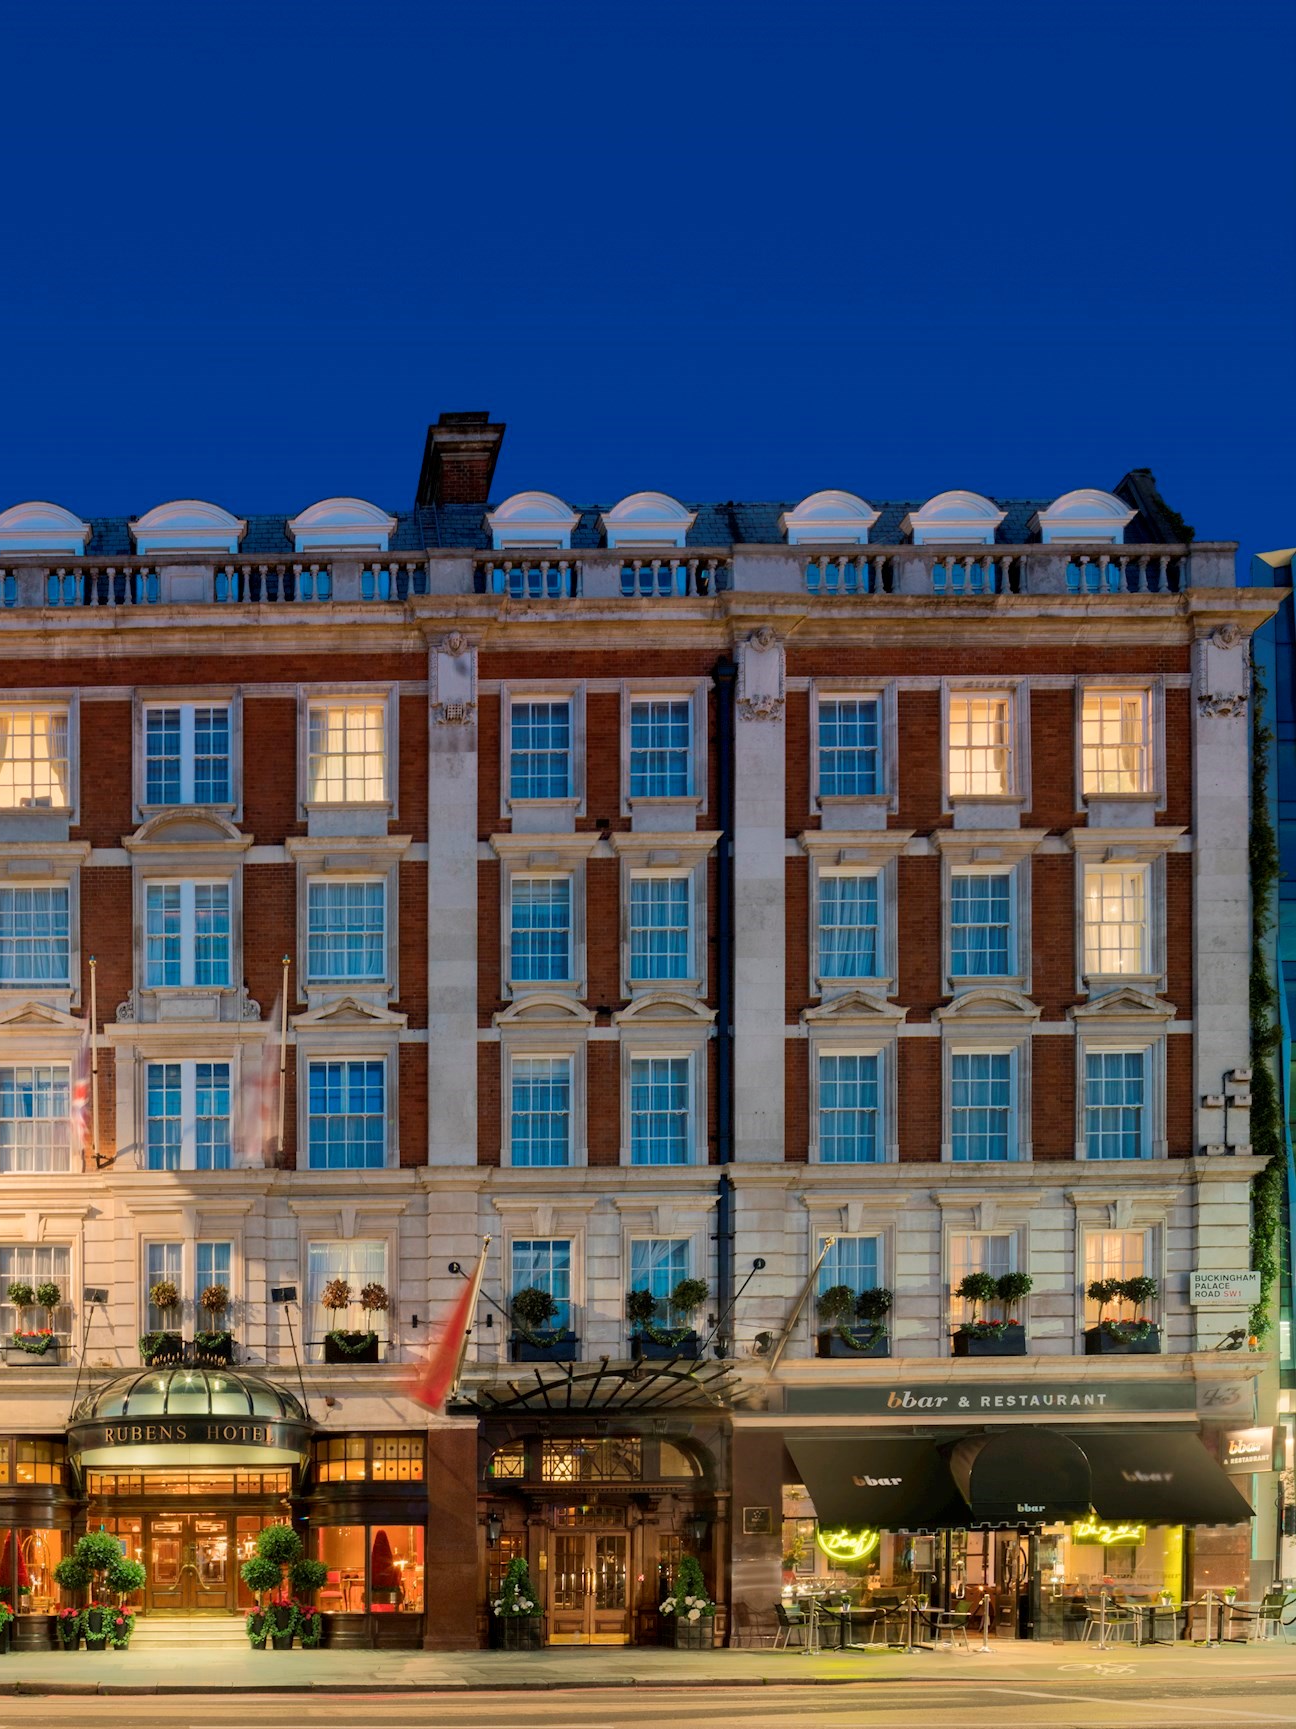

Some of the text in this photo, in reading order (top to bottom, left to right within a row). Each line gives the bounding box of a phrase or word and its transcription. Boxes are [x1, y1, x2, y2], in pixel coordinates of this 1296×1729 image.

[887, 1391, 1107, 1409] bbar & RESTAURANT
[105, 1425, 274, 1443] RUBENS HOTEL
[1228, 1440, 1264, 1455] bbar
[1230, 1454, 1270, 1464] RESTAURANT
[851, 1474, 903, 1487] bbar
[1122, 1470, 1173, 1482] bbar
[1017, 1503, 1046, 1513] bbar
